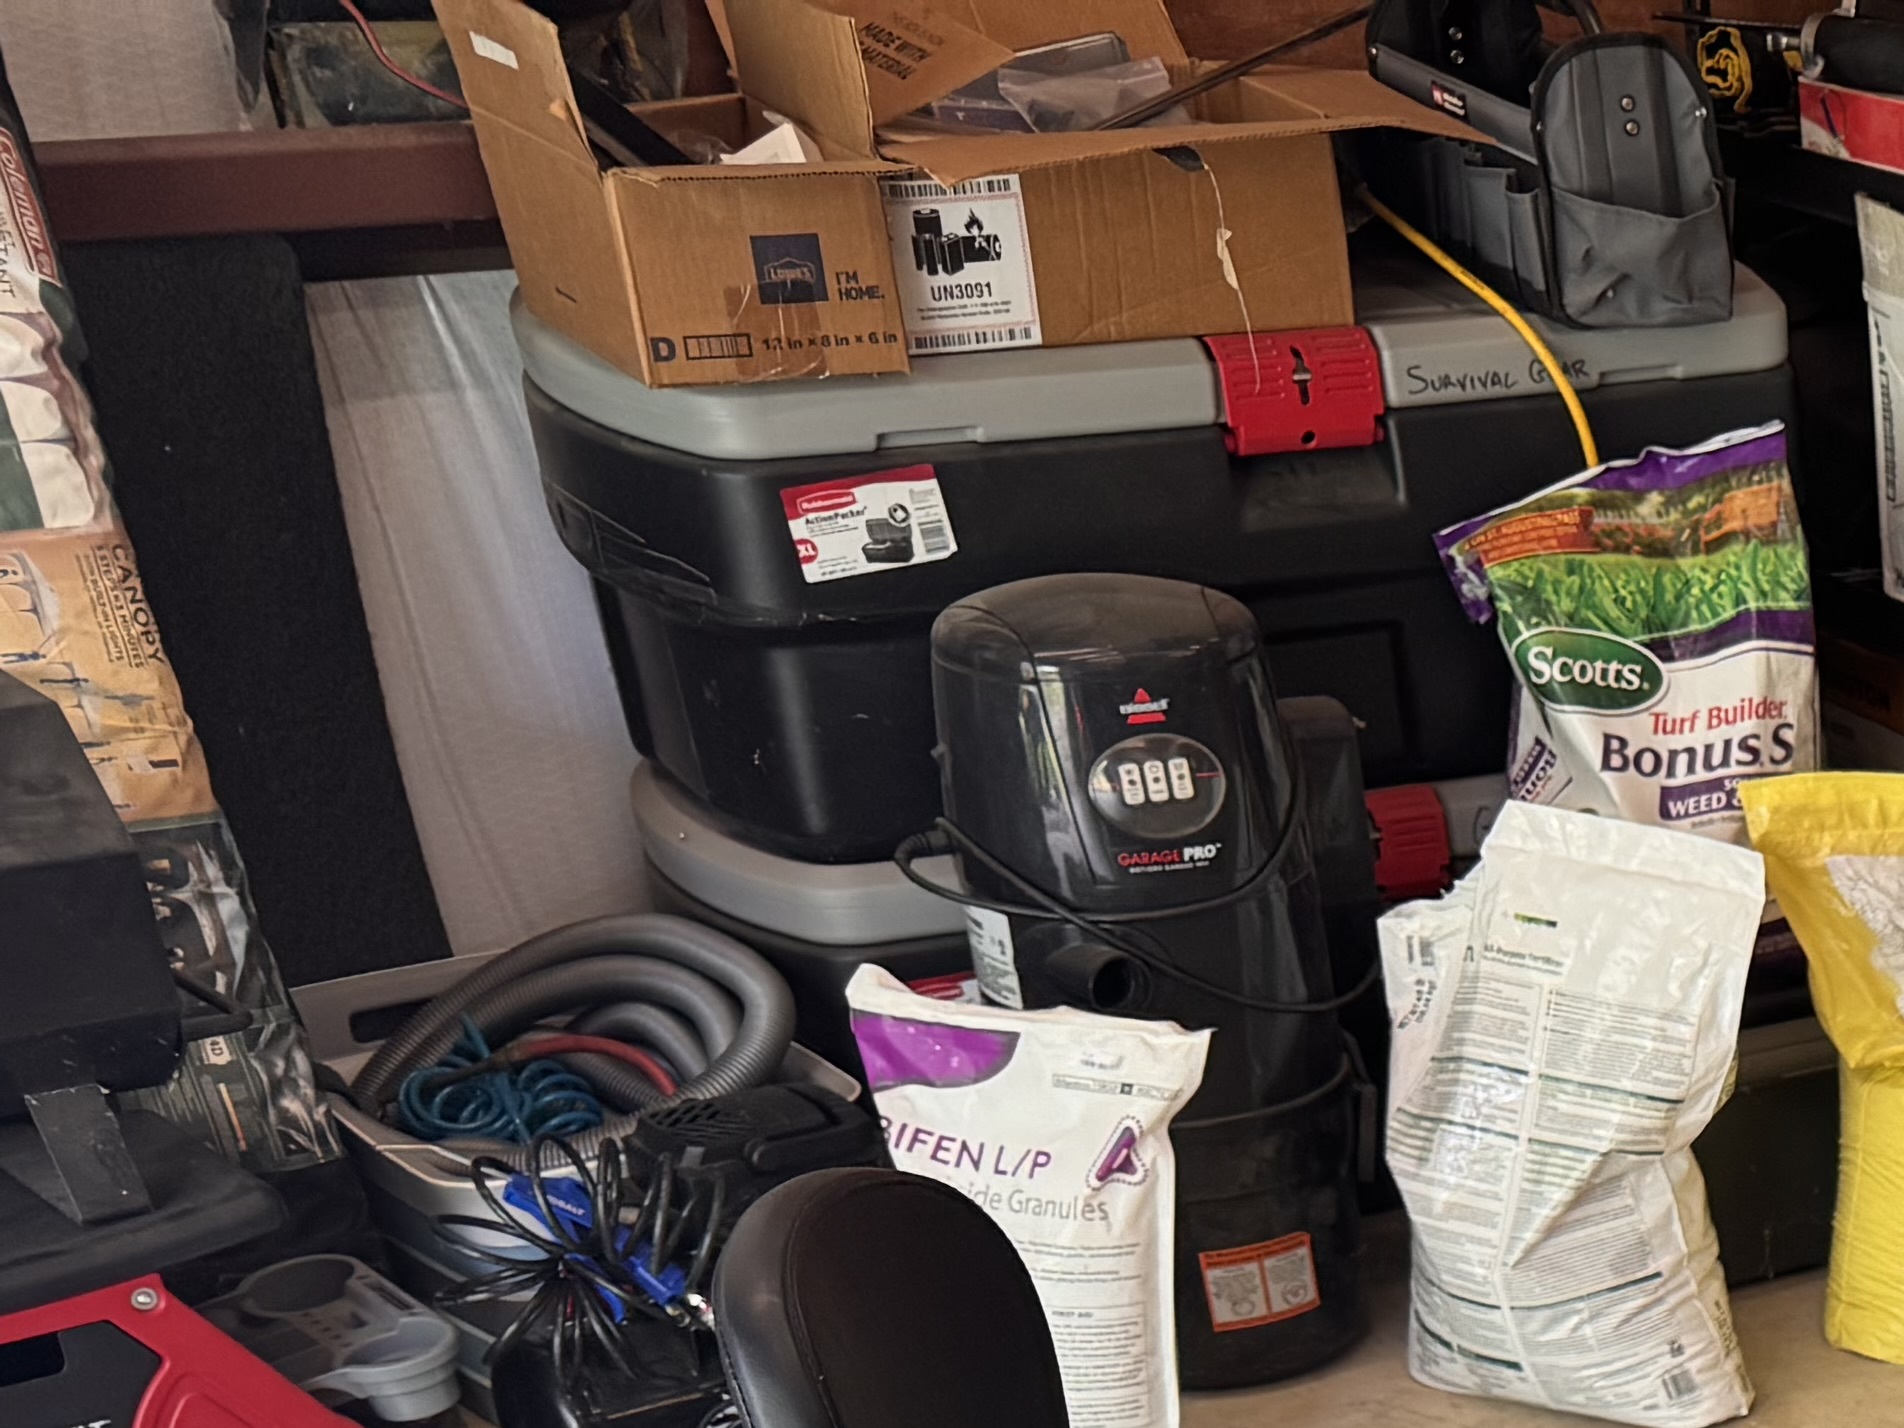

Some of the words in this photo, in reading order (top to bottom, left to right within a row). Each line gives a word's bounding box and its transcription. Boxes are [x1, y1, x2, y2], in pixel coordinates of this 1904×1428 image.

[835, 271, 859, 285] I'M
[838, 286, 885, 301] HOME.
[930, 281, 993, 302] UN3091
[651, 336, 677, 362] D
[1406, 365, 1519, 396] SURVIVAL
[1528, 357, 1590, 384] GAR
[111, 543, 166, 665] CANOPY
[1526, 644, 1643, 692] Scotts
[1650, 708, 1700, 737] Turf
[1706, 696, 1788, 731] Builder
[1600, 731, 1763, 780] Bonus
[1667, 792, 1726, 819] WEED
[1117, 849, 1181, 867] GARAGE
[992, 1144, 1052, 1180] L/P
[1007, 1187, 1110, 1224] Granules
